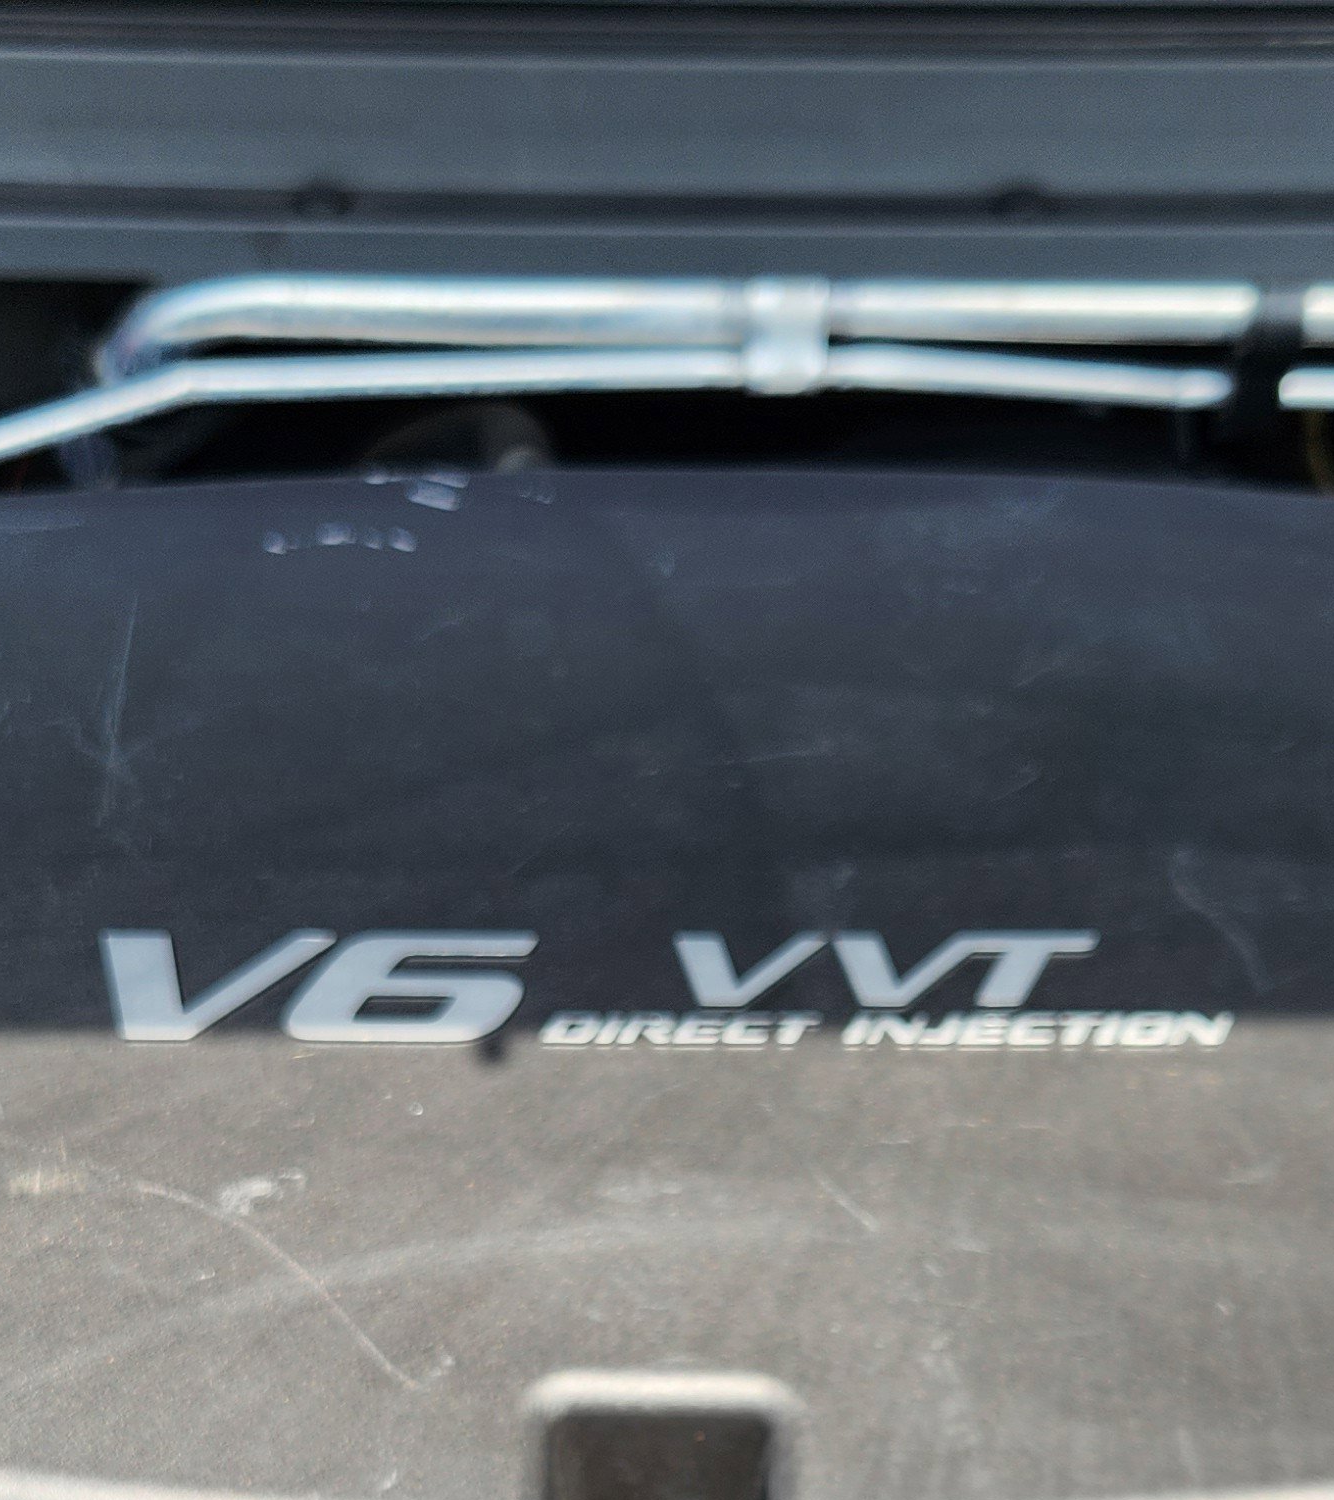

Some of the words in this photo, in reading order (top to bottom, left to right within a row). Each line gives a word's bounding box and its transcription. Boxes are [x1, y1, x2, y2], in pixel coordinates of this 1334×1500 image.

[99, 928, 542, 1045] V6
[674, 928, 1100, 1009] VVT
[538, 1010, 823, 1049] DIRECT
[841, 1010, 1235, 1050] INJECTION
